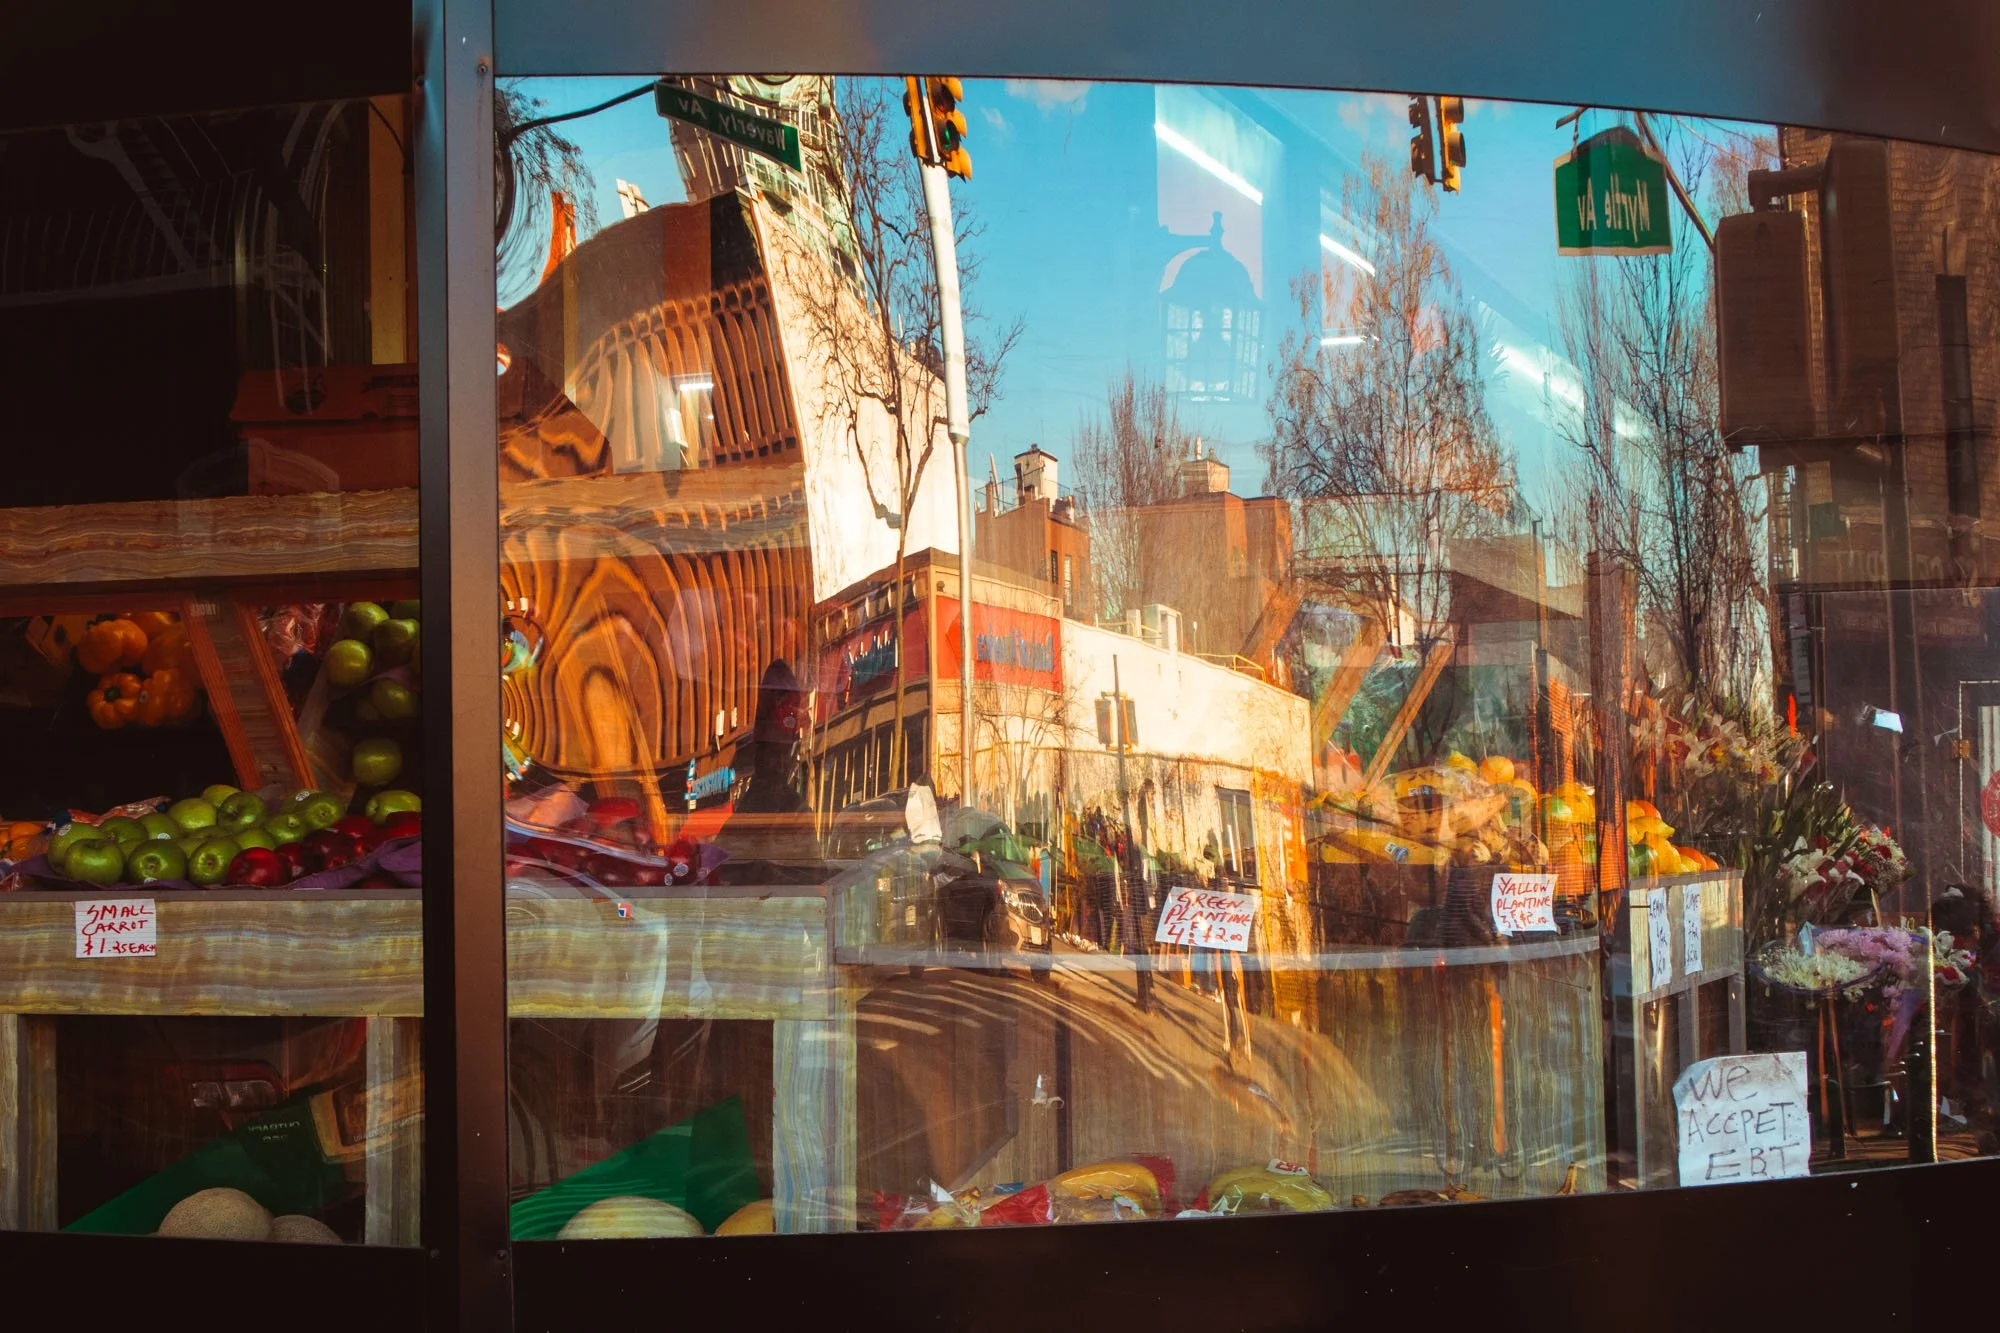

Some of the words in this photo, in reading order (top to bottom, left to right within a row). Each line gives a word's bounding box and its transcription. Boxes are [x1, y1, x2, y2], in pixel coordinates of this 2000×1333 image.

[1498, 877, 1550, 896] YALLOW
[87, 905, 154, 922] SMALL
[82, 920, 149, 936] CARROT
[1704, 1142, 1800, 1181] EBT
